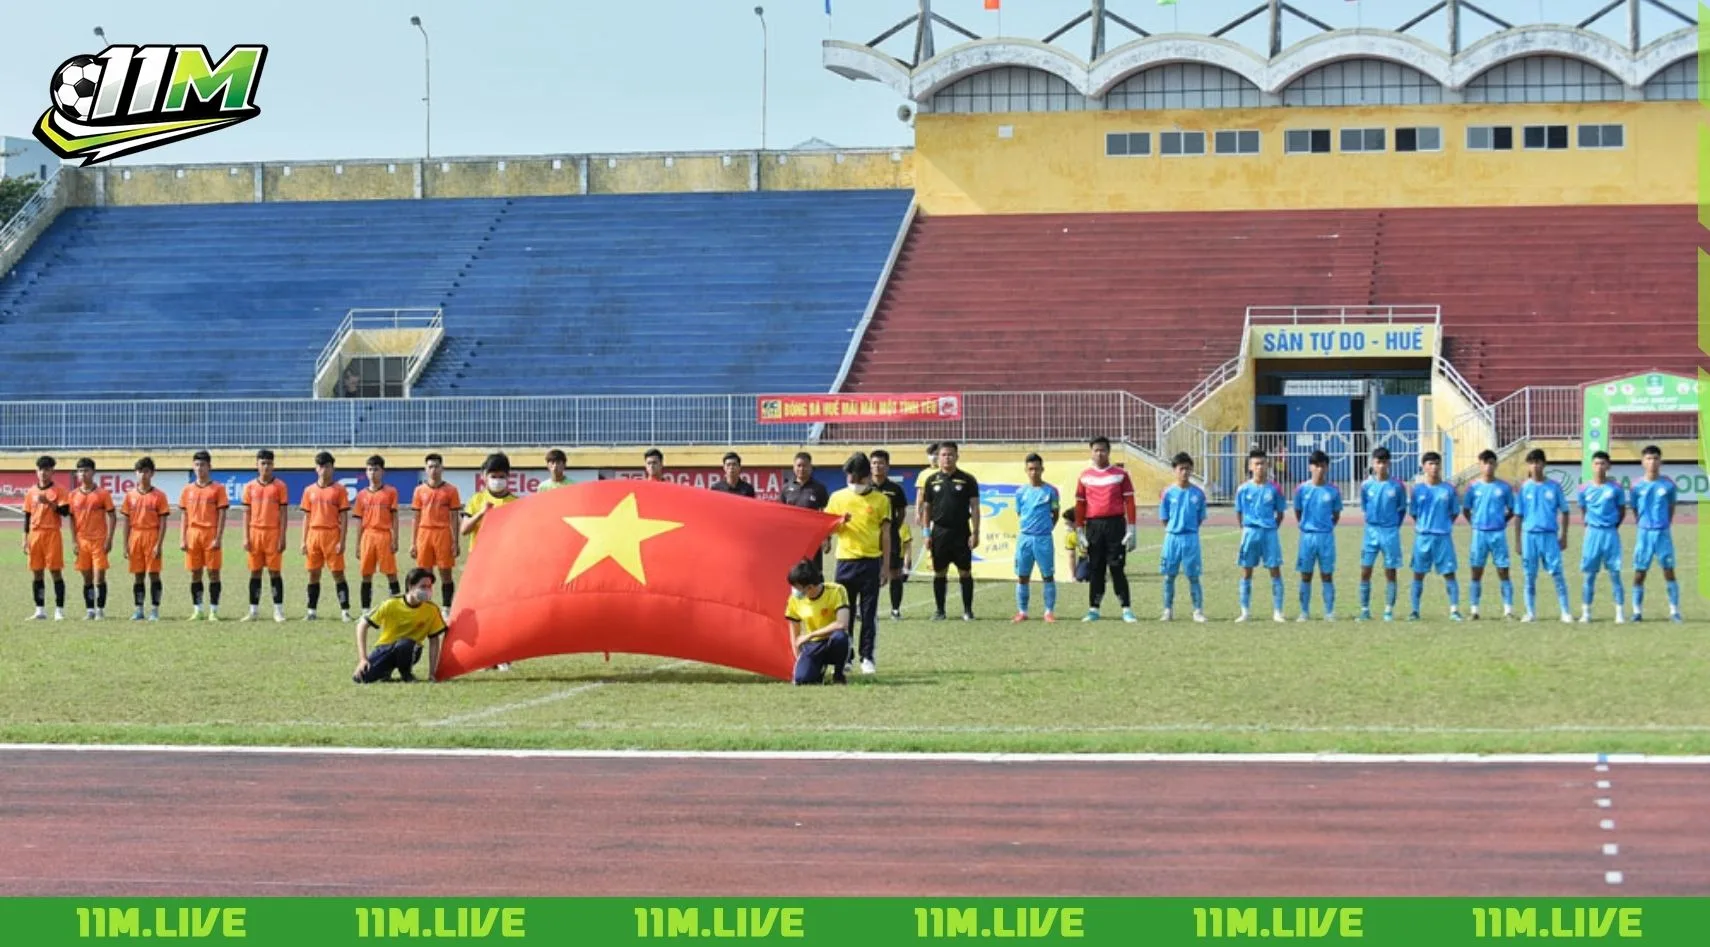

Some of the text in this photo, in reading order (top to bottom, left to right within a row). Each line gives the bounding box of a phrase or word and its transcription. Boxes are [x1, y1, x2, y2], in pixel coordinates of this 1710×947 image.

[1263, 328, 1303, 351] SÂN
[1309, 330, 1335, 355] TỰ
[1339, 331, 1365, 350] DO
[1385, 326, 1424, 350] HUẾ
